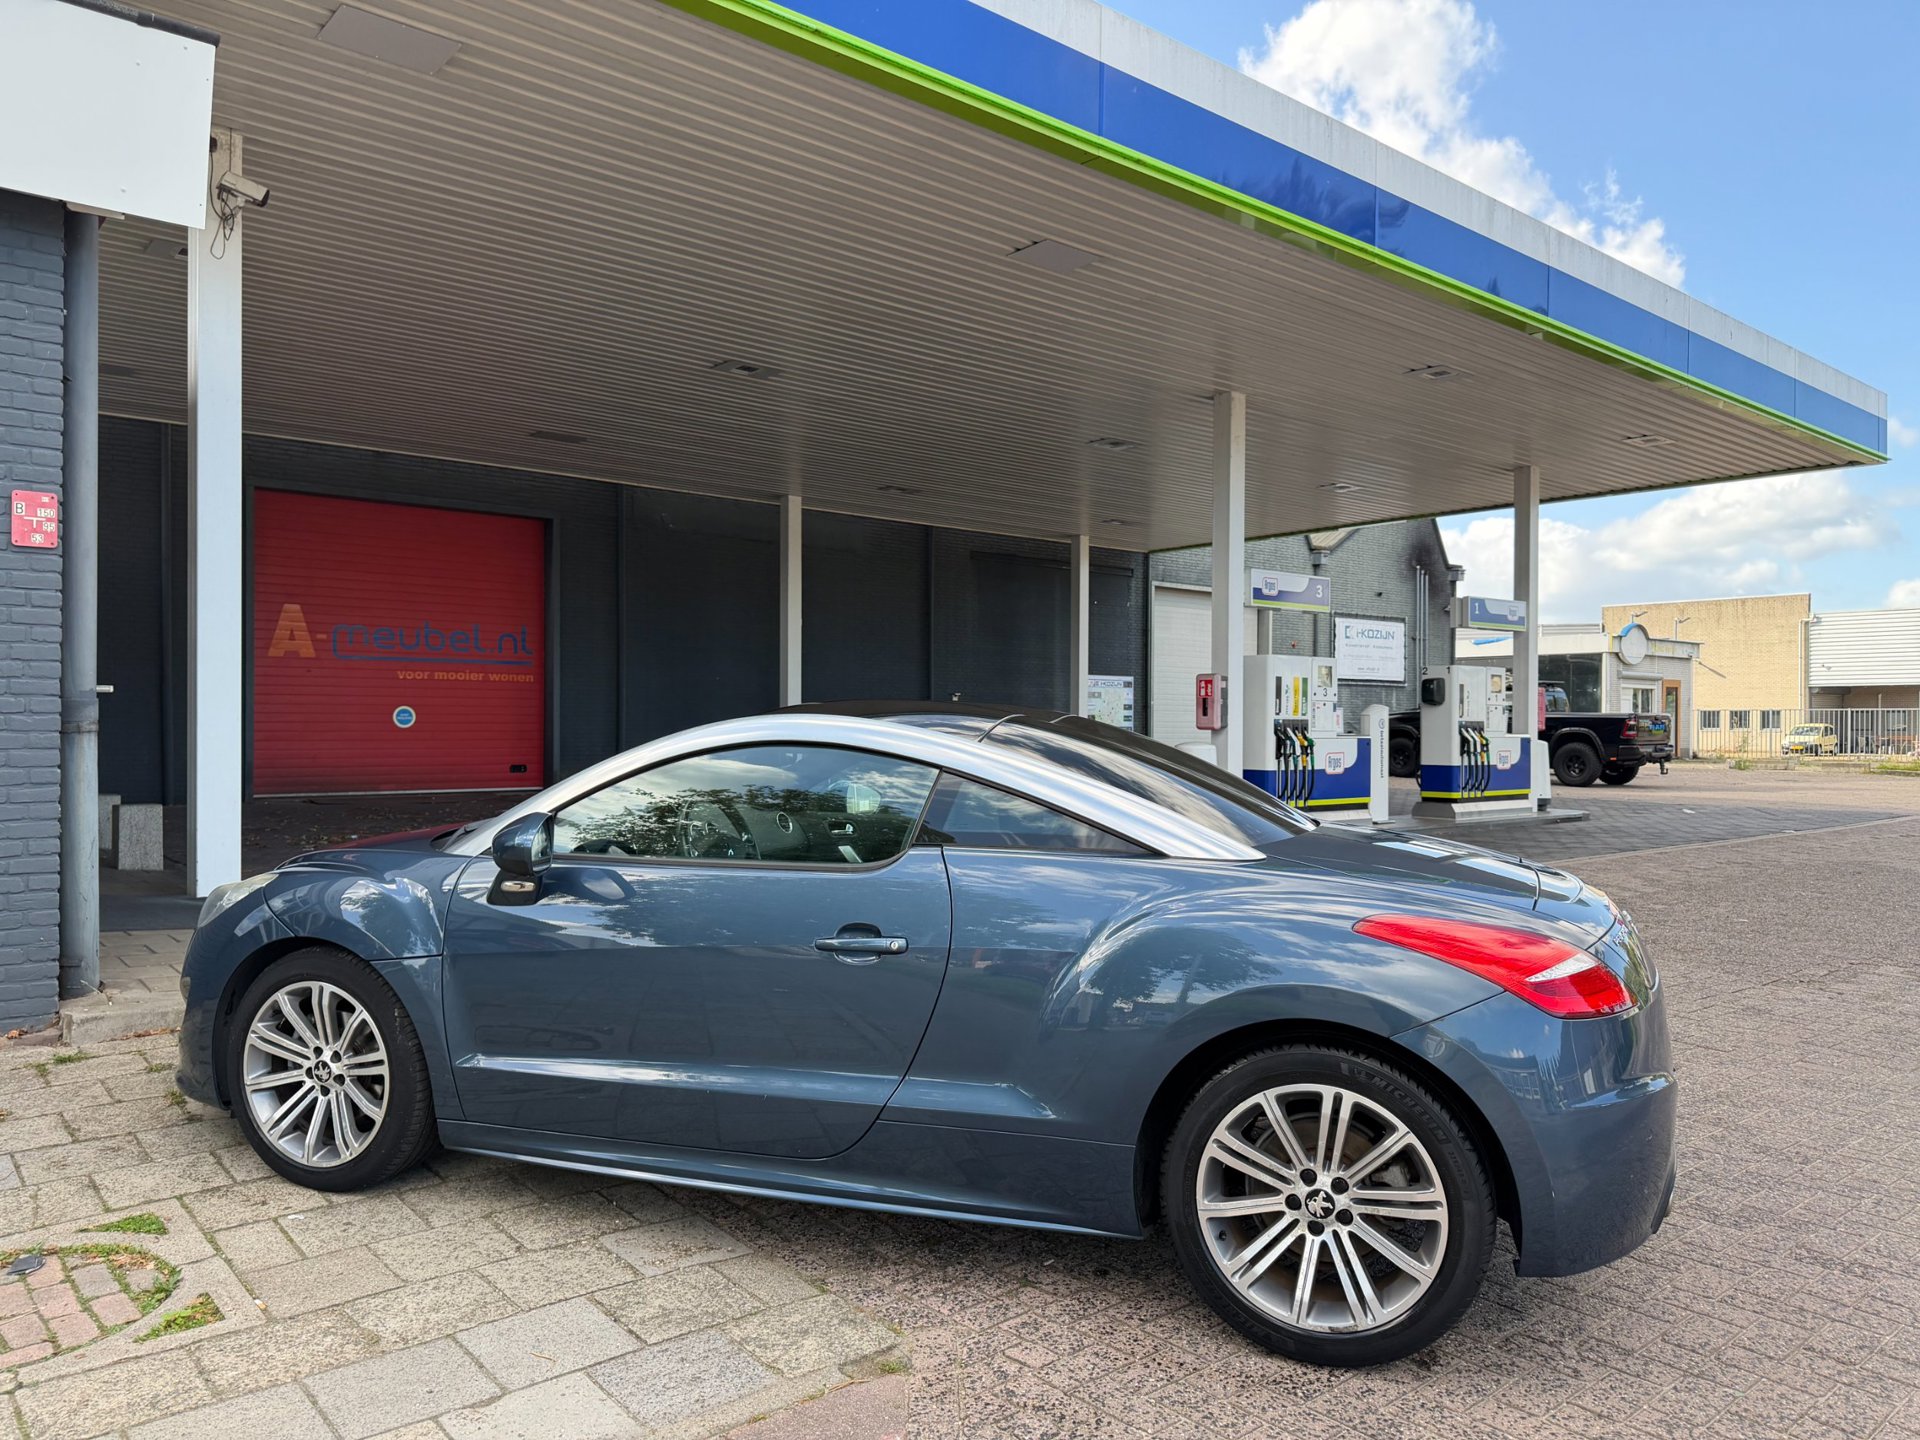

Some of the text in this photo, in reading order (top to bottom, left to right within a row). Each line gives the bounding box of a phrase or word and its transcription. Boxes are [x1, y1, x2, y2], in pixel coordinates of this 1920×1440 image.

[16, 503, 23, 514] B
[39, 509, 55, 517] 150
[1315, 585, 1323, 598] 3
[1475, 603, 1479, 614] 1
[1422, 667, 1428, 675] 2
[1446, 666, 1450, 674] 1
[397, 669, 534, 683] voor mooier wonen
[1322, 687, 1328, 697] 3
